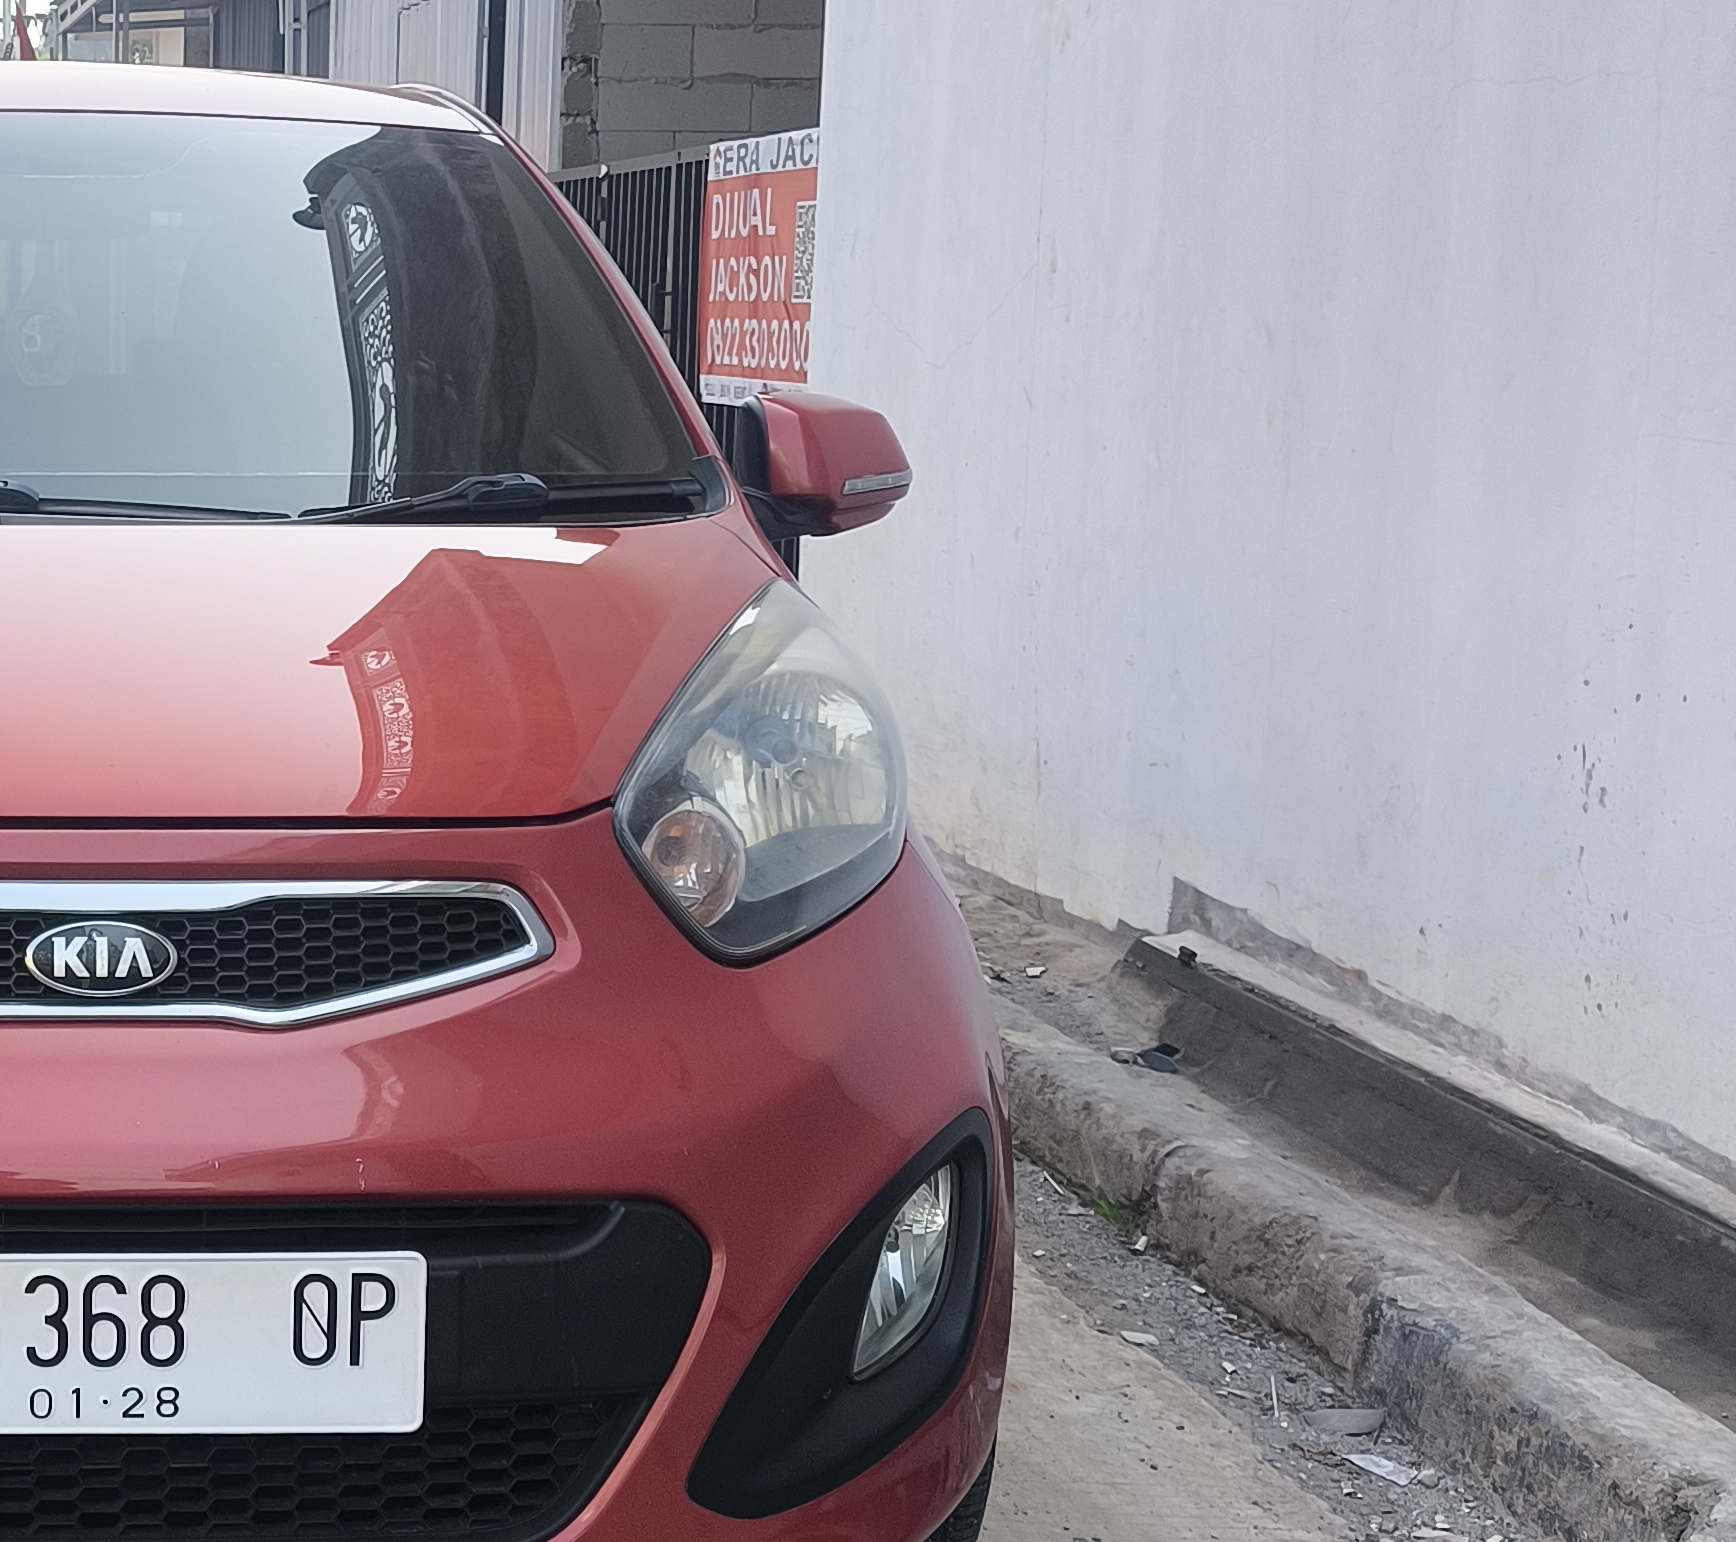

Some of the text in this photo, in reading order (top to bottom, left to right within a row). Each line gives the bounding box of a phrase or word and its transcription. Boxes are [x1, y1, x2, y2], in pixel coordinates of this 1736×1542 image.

[722, 141, 761, 177] ERA
[711, 187, 777, 239] DIJUAL
[708, 255, 787, 302] JACKSON
[51, 936, 154, 978] KIA
